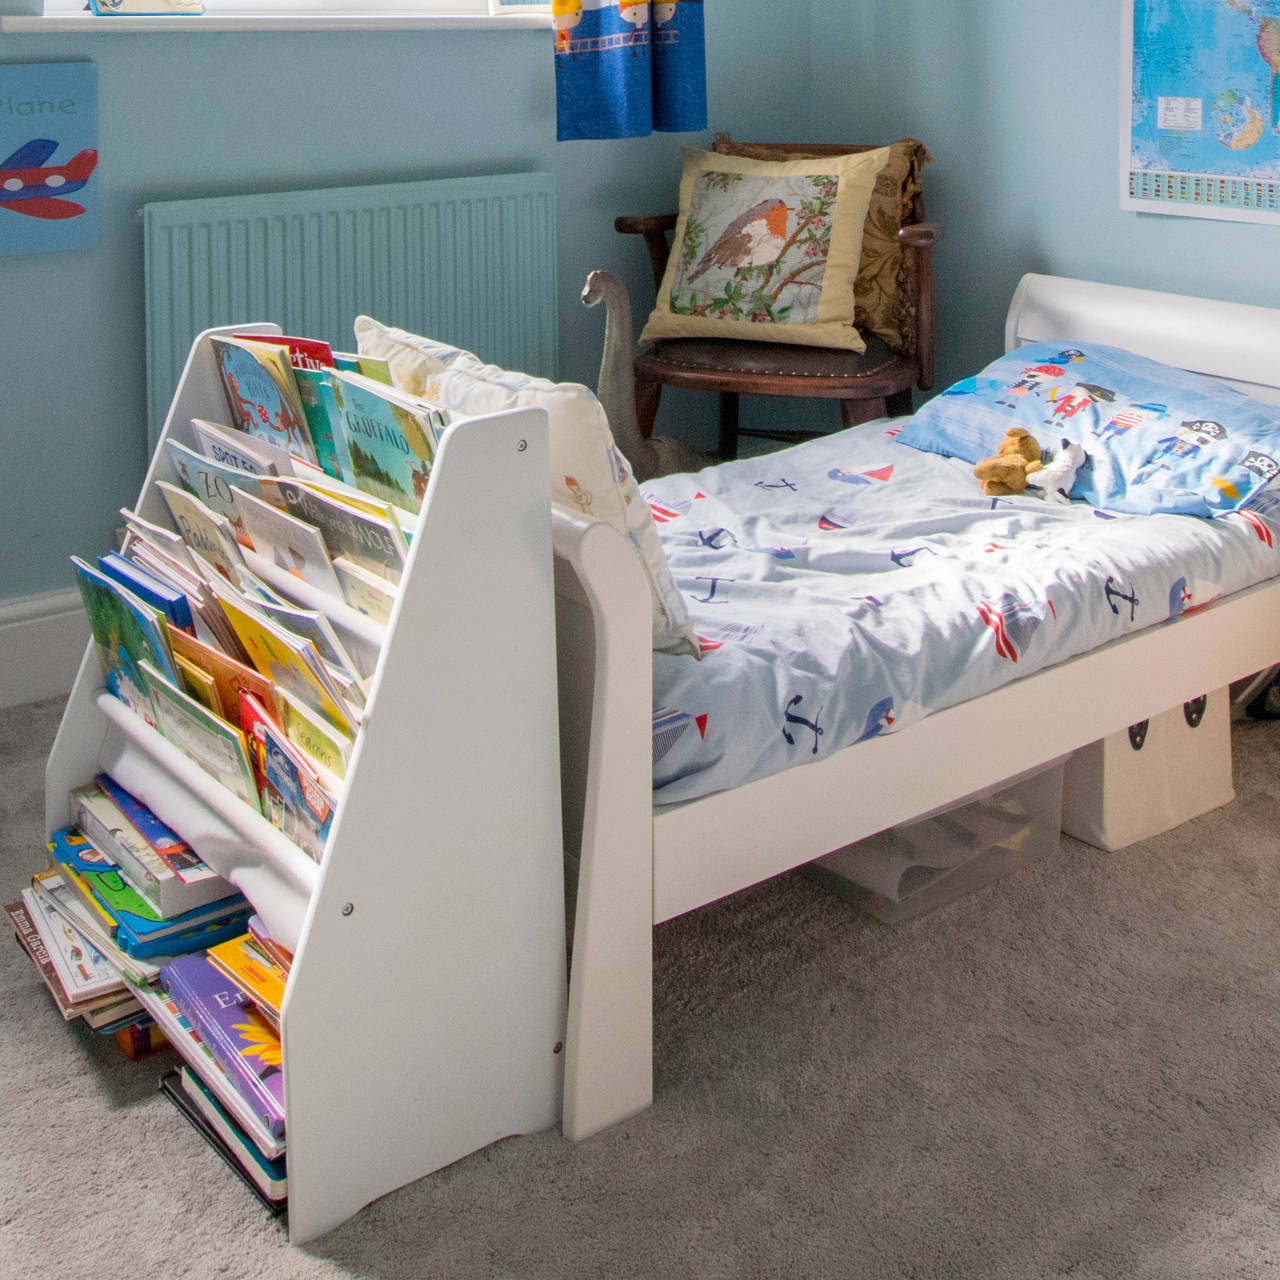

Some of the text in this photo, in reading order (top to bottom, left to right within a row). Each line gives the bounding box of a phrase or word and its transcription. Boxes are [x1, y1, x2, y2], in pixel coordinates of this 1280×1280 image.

[346, 411, 410, 455] GRUFFALO
[199, 471, 234, 504] ZO
[10, 909, 33, 935] Emma
